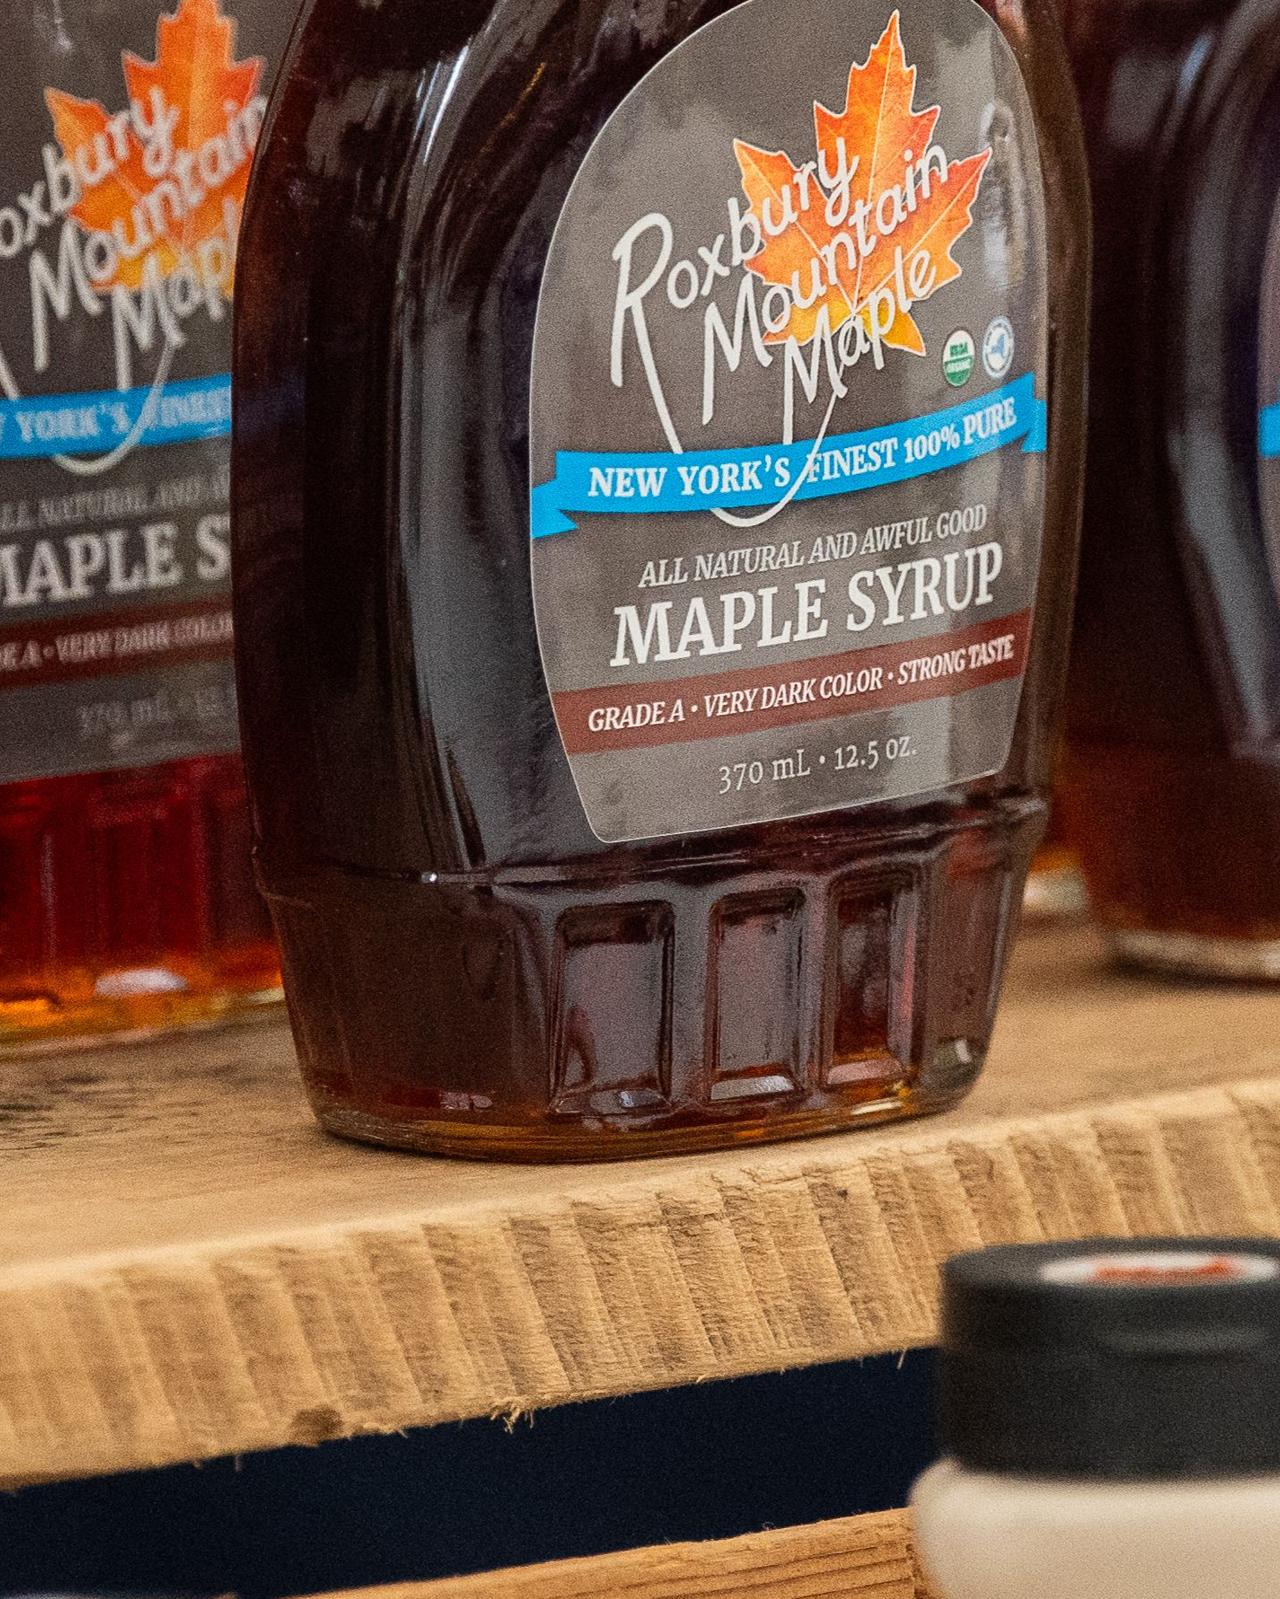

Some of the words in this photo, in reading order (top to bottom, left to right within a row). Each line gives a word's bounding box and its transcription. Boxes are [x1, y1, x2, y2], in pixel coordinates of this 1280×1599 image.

[112, 196, 237, 390] Mapl
[610, 137, 860, 454] Roxbury
[702, 143, 948, 426] Mountain
[783, 246, 937, 444] Maple
[16, 404, 127, 442] YORK'S
[588, 466, 670, 497] NEW
[677, 456, 790, 496] YORK'S
[806, 441, 898, 483] FINEST
[904, 426, 961, 463] 100%
[962, 396, 1018, 444] PURE
[638, 560, 688, 588] ALL
[694, 546, 805, 583] NATURAL
[809, 533, 857, 566] AND
[861, 521, 933, 558] AWFUL
[937, 503, 988, 539] GOOD
[609, 578, 828, 667] MAPLE
[845, 541, 1004, 633] SYRUP
[588, 702, 669, 732] GRADE
[663, 697, 686, 725] A
[704, 692, 760, 718] VERY
[761, 679, 817, 711] DARK
[819, 667, 884, 699] COLOR
[897, 650, 966, 686] STRONG
[965, 633, 1016, 671] TASTE
[718, 764, 764, 795] 370
[771, 749, 811, 780] mL
[833, 739, 880, 771] 12.5
[884, 734, 918, 765] oz.
